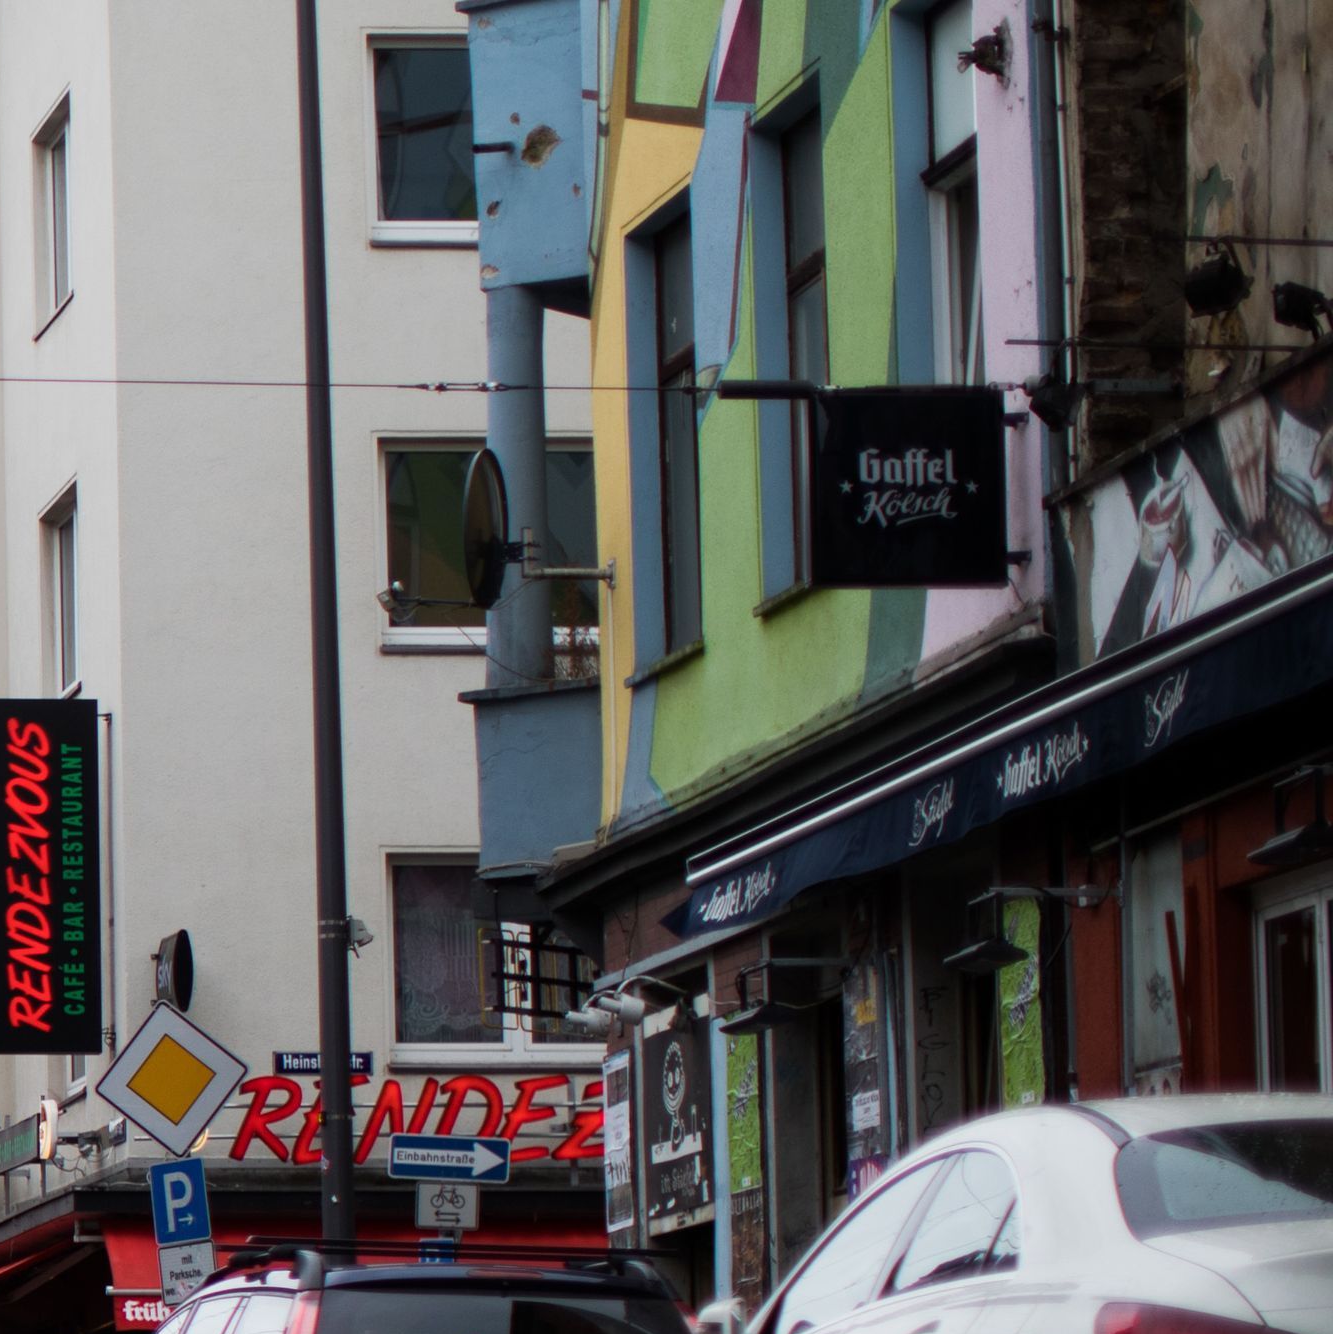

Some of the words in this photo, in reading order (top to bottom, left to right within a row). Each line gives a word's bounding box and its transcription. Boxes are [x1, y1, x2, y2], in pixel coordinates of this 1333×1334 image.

[859, 448, 957, 487] Gaffel
[857, 487, 958, 528] Kölsch
[1003, 742, 1041, 797] Gaffel
[60, 743, 85, 880] RESTAURANT
[5, 717, 51, 1032] RENDEZVOUS
[63, 901, 85, 941] BAR
[60, 963, 85, 1015] CAFÉ
[396, 1151, 476, 1165] Einbahnstraße
[163, 1171, 193, 1233] P
[182, 1254, 193, 1265] mit
[123, 1301, 171, 1322] früh
